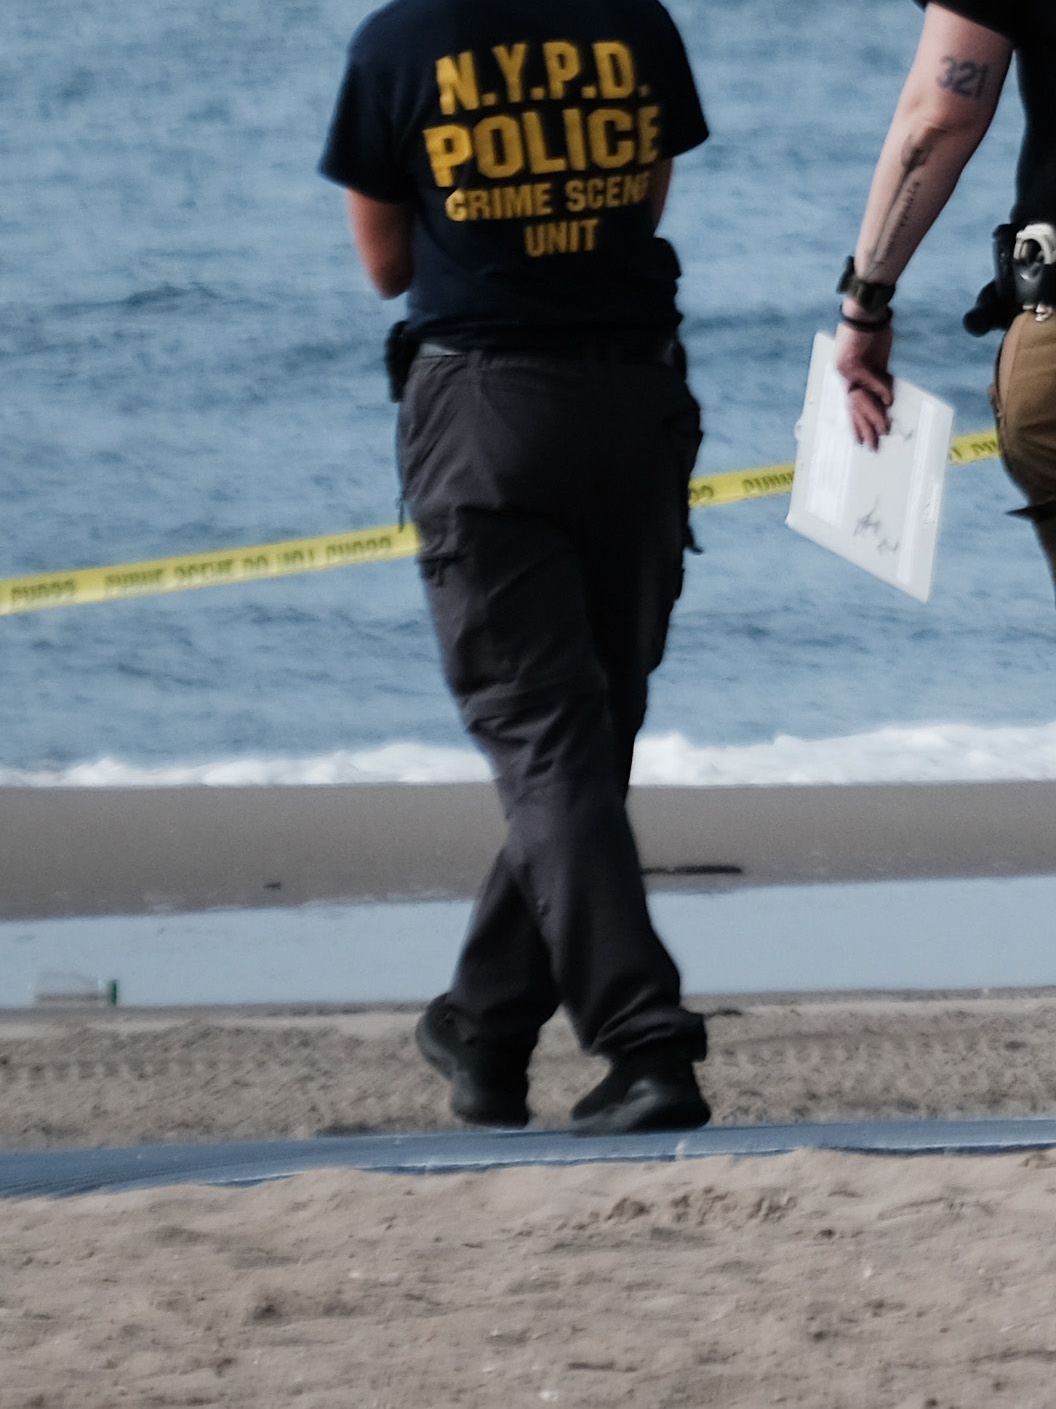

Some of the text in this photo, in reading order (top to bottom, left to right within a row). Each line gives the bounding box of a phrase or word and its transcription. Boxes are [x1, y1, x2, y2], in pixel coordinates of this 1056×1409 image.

[435, 40, 650, 115] N.Y.P.D.
[422, 104, 661, 188] POLICE
[445, 182, 553, 222] CRIME
[525, 218, 598, 258] UNIT
